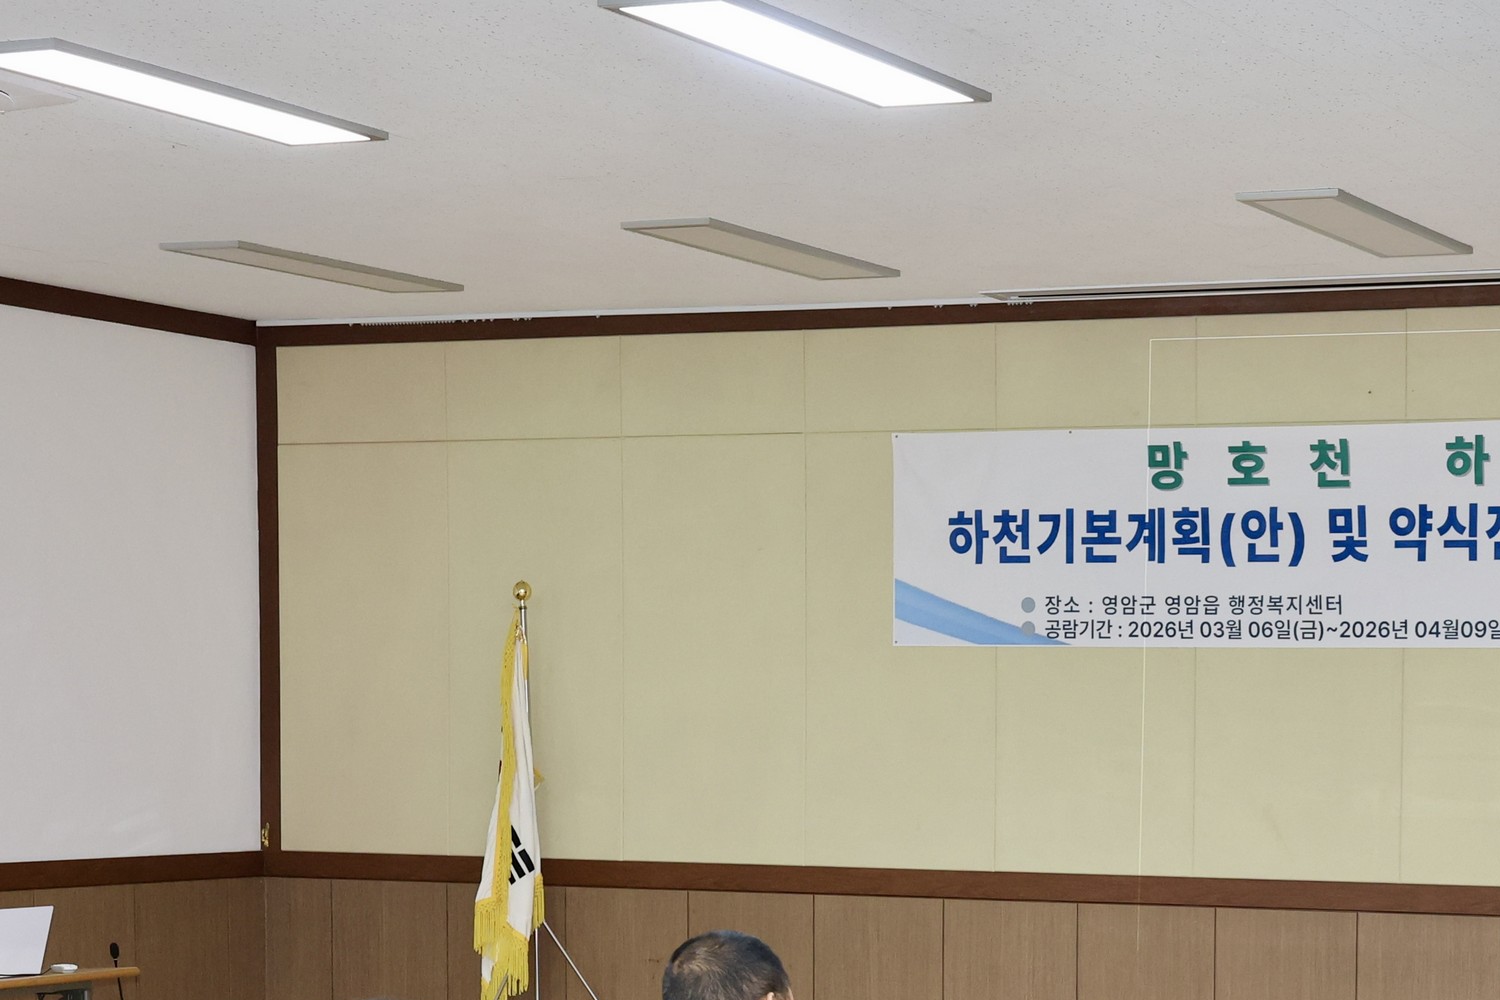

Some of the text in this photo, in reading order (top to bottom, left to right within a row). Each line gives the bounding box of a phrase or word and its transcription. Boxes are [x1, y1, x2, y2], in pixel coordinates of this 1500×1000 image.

[948, 507, 1305, 567] 하천기본계획(안)
[1329, 505, 1368, 562] 및
[1045, 595, 1080, 615] 장소
[1102, 595, 1156, 615] 영암군
[1165, 595, 1220, 615] 영암읍
[1229, 594, 1342, 615] 행정복지센터
[1128, 620, 1193, 639] 2026년
[1200, 620, 1242, 639] 03월
[1249, 619, 1408, 641] 06일(금)~2026년
